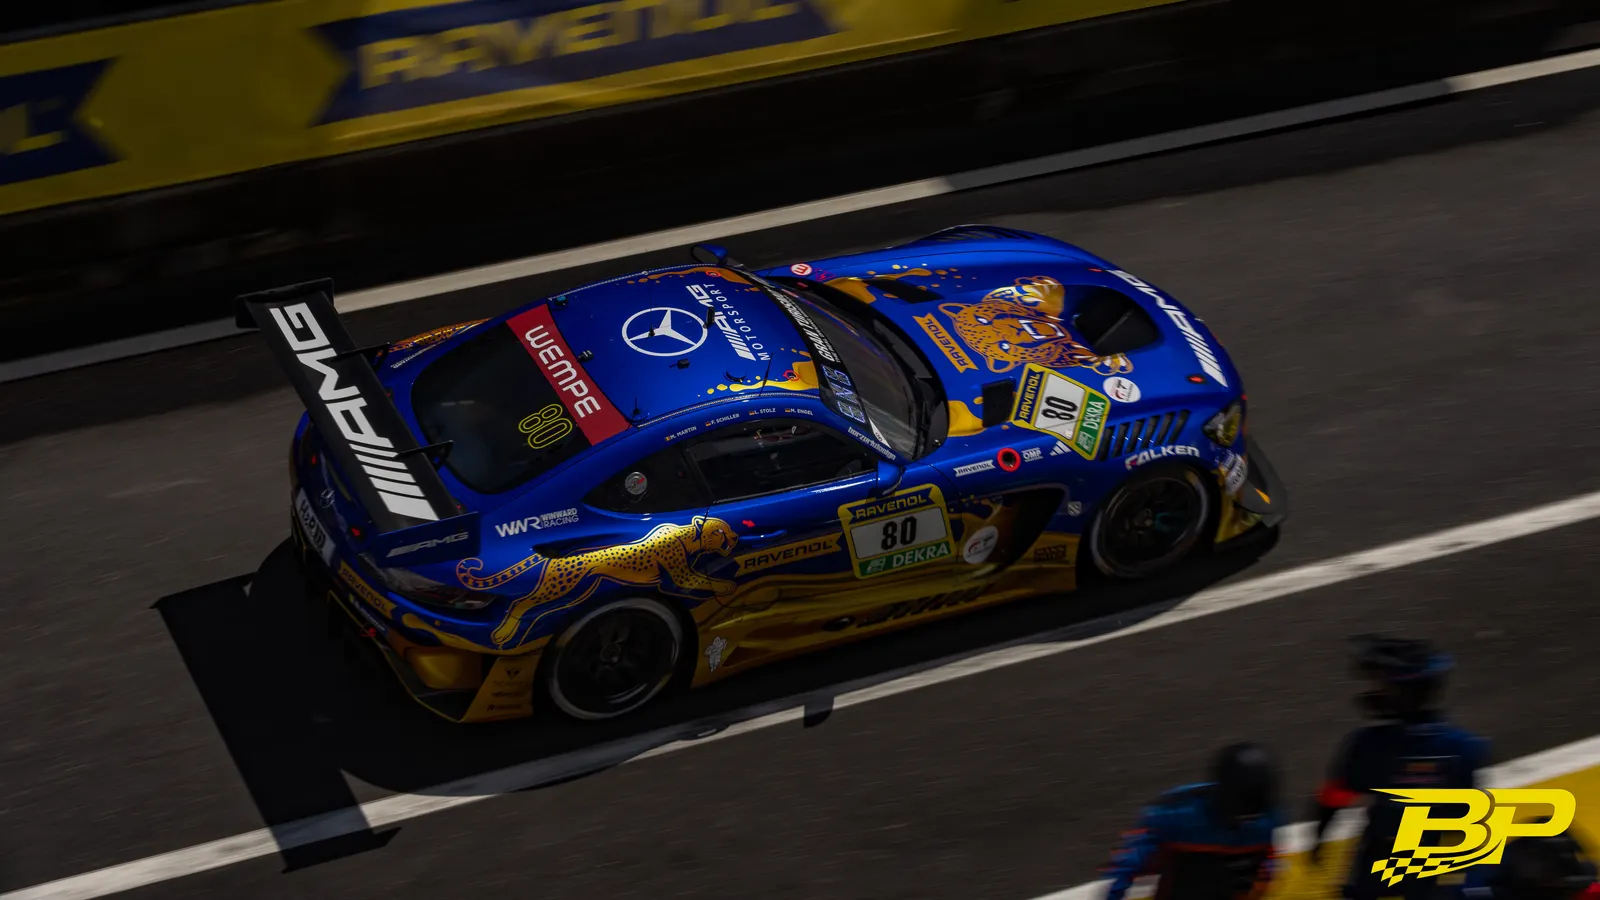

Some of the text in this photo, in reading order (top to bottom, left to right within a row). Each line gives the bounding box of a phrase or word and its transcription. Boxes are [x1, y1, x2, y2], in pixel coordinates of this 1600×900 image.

[703, 283, 770, 361] MOTORSPORT
[927, 317, 969, 367] RAVENOL
[525, 324, 601, 418] WEMPE
[1019, 373, 1041, 420] RAVENOL
[1041, 395, 1078, 421] 80
[518, 403, 573, 449] 80
[716, 413, 740, 424] SCHILLER
[1082, 400, 1106, 431] DEKRA
[676, 425, 697, 438] MARTIN
[1022, 449, 1042, 460] OMP
[1125, 444, 1200, 471] FALKEN
[958, 462, 992, 475] RAVENOL
[540, 507, 578, 521] WINWARD
[855, 494, 927, 520] RAVENOL
[543, 514, 579, 529] RACING
[881, 516, 917, 550] 80
[743, 536, 833, 569] RAVENOL
[892, 542, 949, 568] DEKRA
